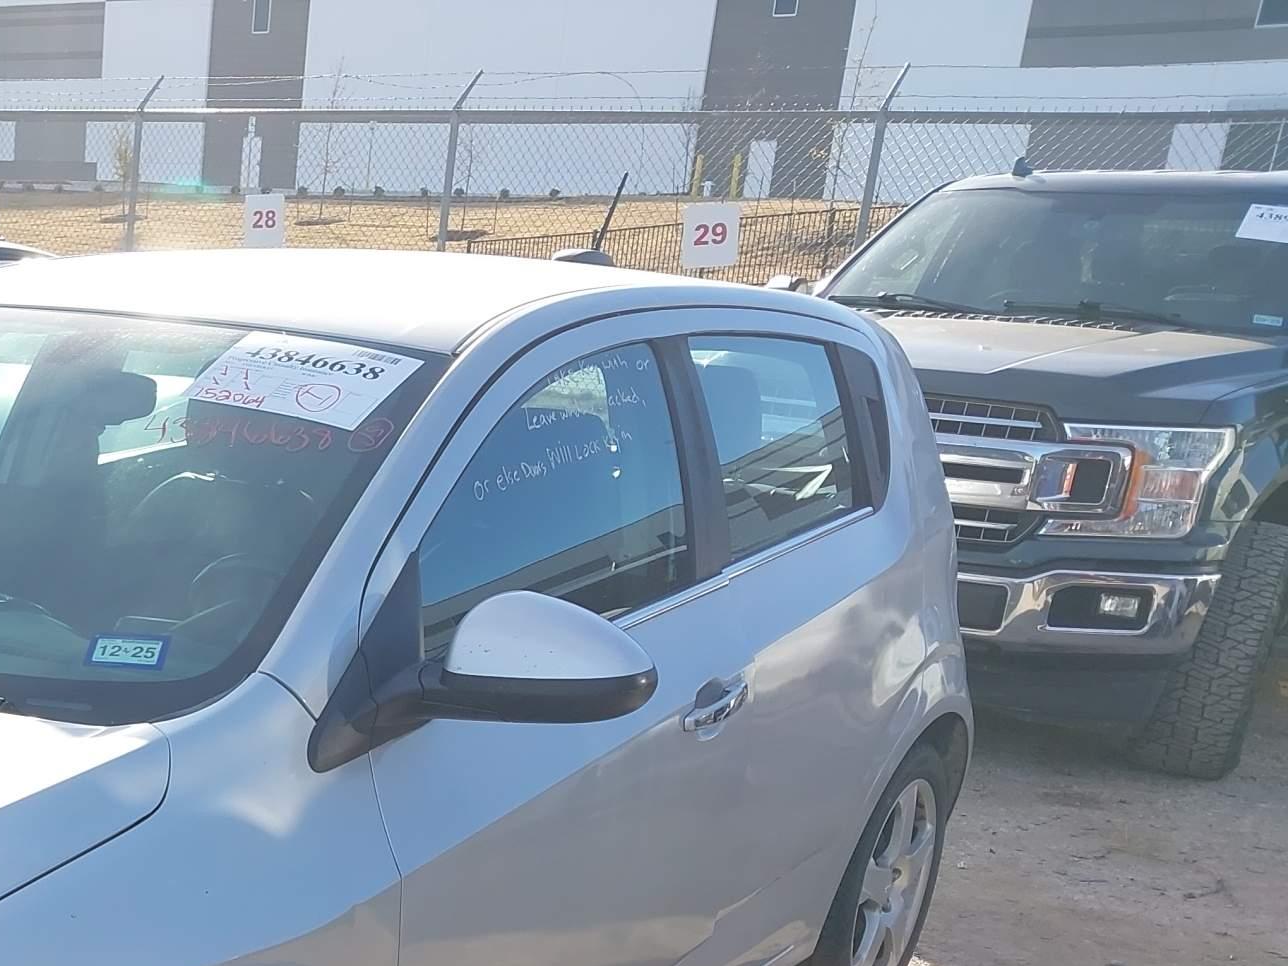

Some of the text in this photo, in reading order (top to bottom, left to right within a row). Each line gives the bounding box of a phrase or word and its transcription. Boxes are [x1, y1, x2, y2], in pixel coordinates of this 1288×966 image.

[252, 210, 276, 229] 28
[693, 222, 728, 246] 29
[245, 346, 386, 380] 43846638
[130, 646, 157, 659] 25
